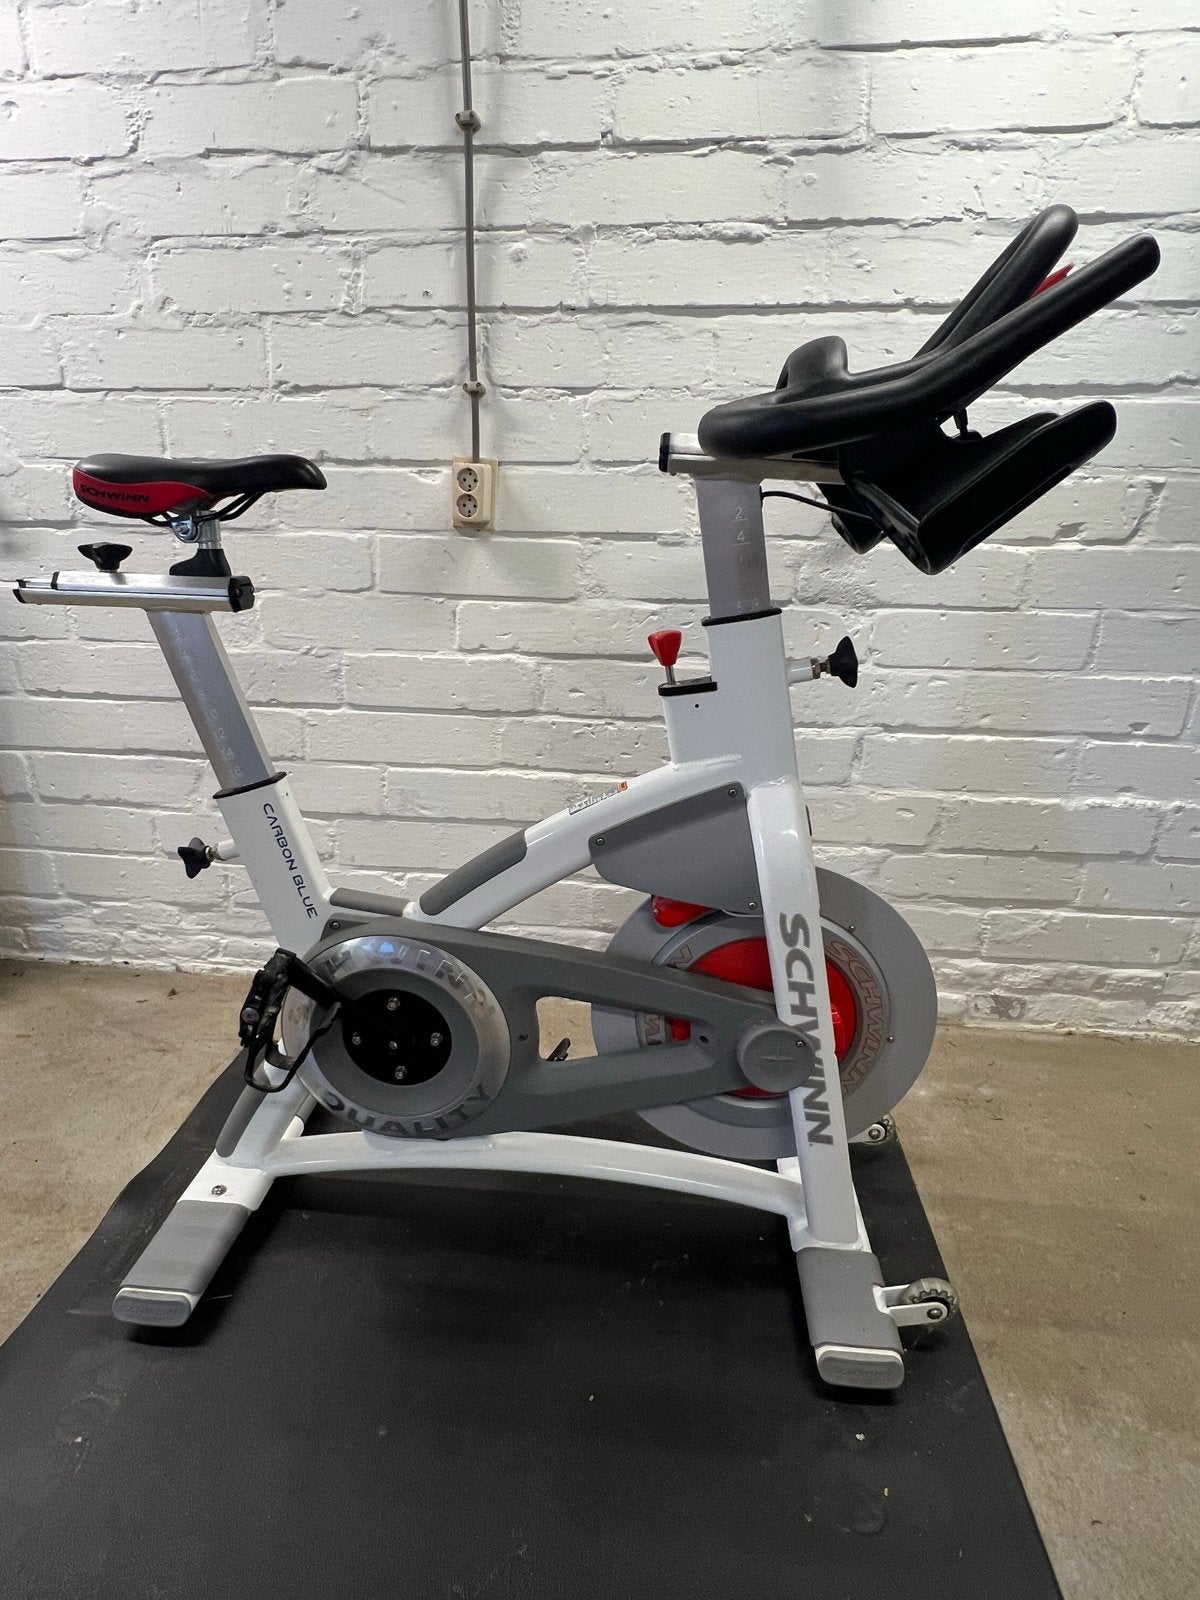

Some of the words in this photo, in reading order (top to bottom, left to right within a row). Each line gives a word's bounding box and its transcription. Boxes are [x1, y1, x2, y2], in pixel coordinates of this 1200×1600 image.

[80, 484, 150, 503] SCHWINN
[736, 506, 743, 519] 2
[736, 531, 745, 542] 4
[262, 803, 297, 872] CARBON
[292, 874, 319, 919] BLUE
[323, 1083, 489, 1136] QUALITY
